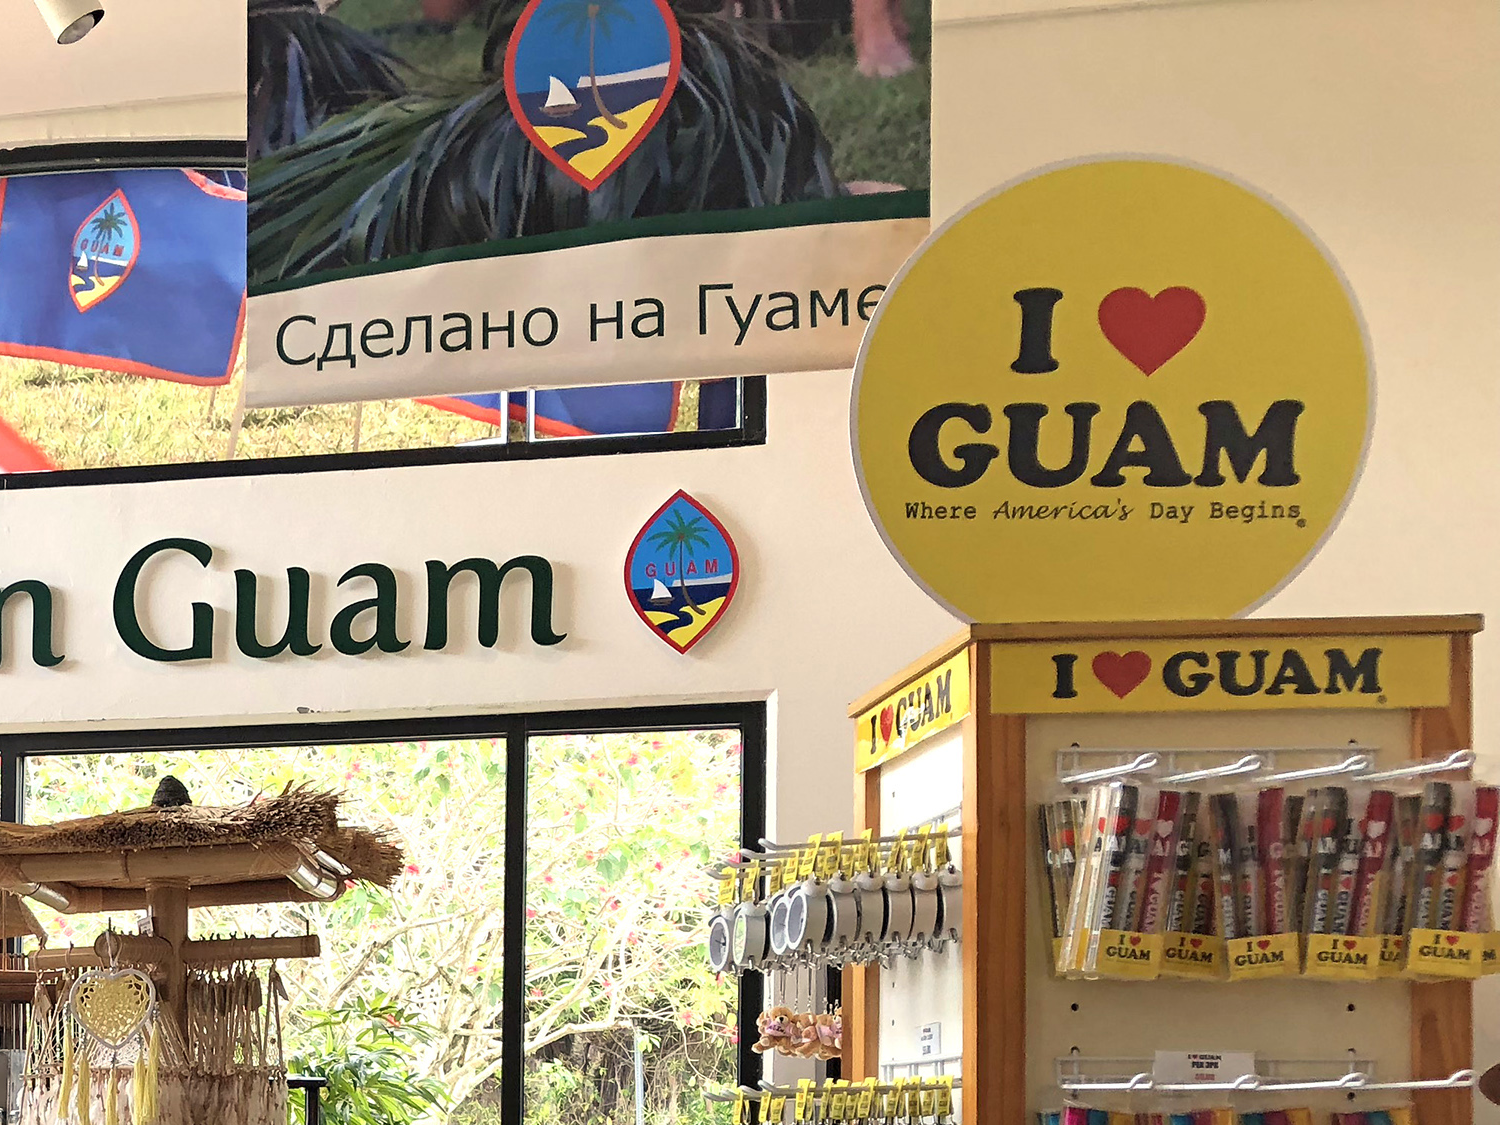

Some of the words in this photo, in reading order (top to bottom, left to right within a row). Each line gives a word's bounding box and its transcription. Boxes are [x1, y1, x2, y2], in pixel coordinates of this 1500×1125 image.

[275, 305, 560, 371] Сделано
[589, 296, 666, 341] на
[698, 282, 888, 346] Гуаме
[1010, 287, 1063, 374] I
[908, 399, 1305, 489] GUAM
[905, 502, 977, 520] Where
[993, 498, 1134, 521] America's
[1150, 502, 1194, 524] Day
[645, 557, 720, 578] GUAM
[112, 537, 568, 663] Guam
[1052, 653, 1078, 699] I
[1162, 648, 1383, 697] GUAM
[870, 714, 877, 754] I
[896, 669, 952, 738] GUAM
[1106, 946, 1150, 961] GUAM
[1166, 948, 1213, 963] GUAM
[1235, 951, 1285, 966] GUAM
[1317, 951, 1368, 965] GUAM
[1418, 946, 1471, 961] GUAM
